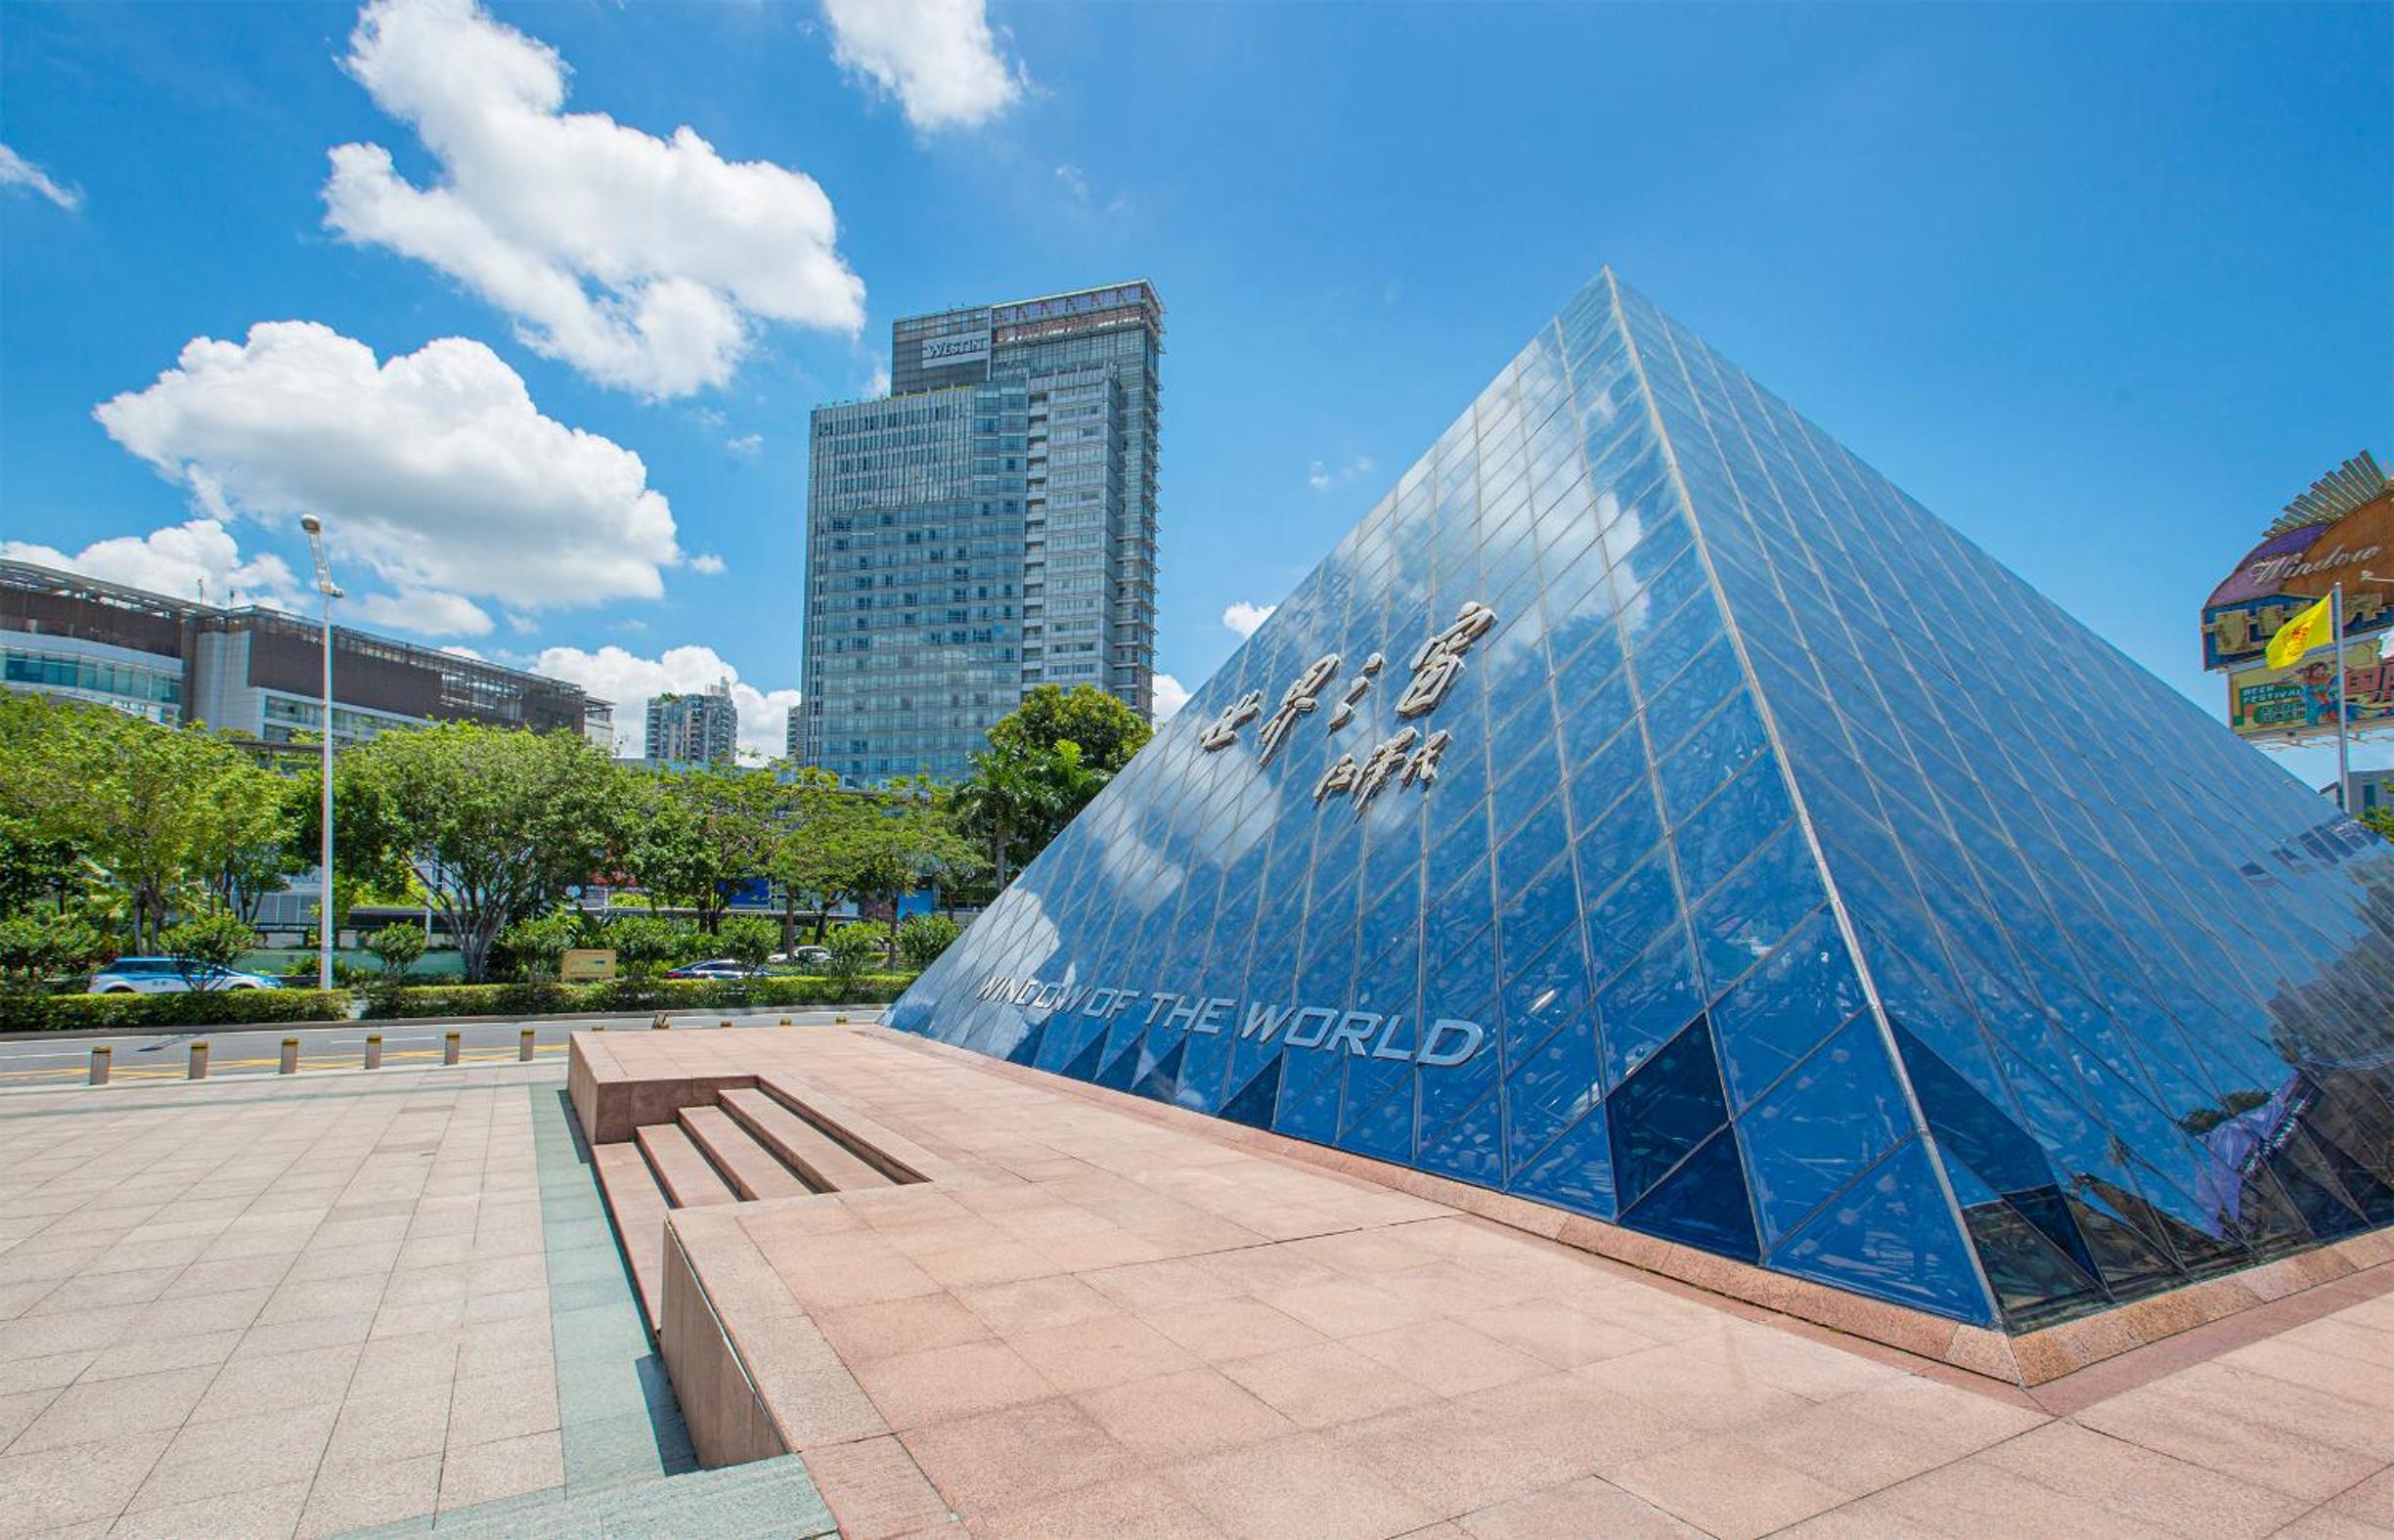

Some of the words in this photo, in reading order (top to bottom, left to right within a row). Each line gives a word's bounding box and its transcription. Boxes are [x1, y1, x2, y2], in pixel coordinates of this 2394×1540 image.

[2249, 544, 2382, 585] Window
[977, 976, 1092, 1013] WINDOW
[1083, 987, 1141, 1020] OF
[1145, 990, 1236, 1034] THE
[1241, 1001, 1484, 1067] WORLD
